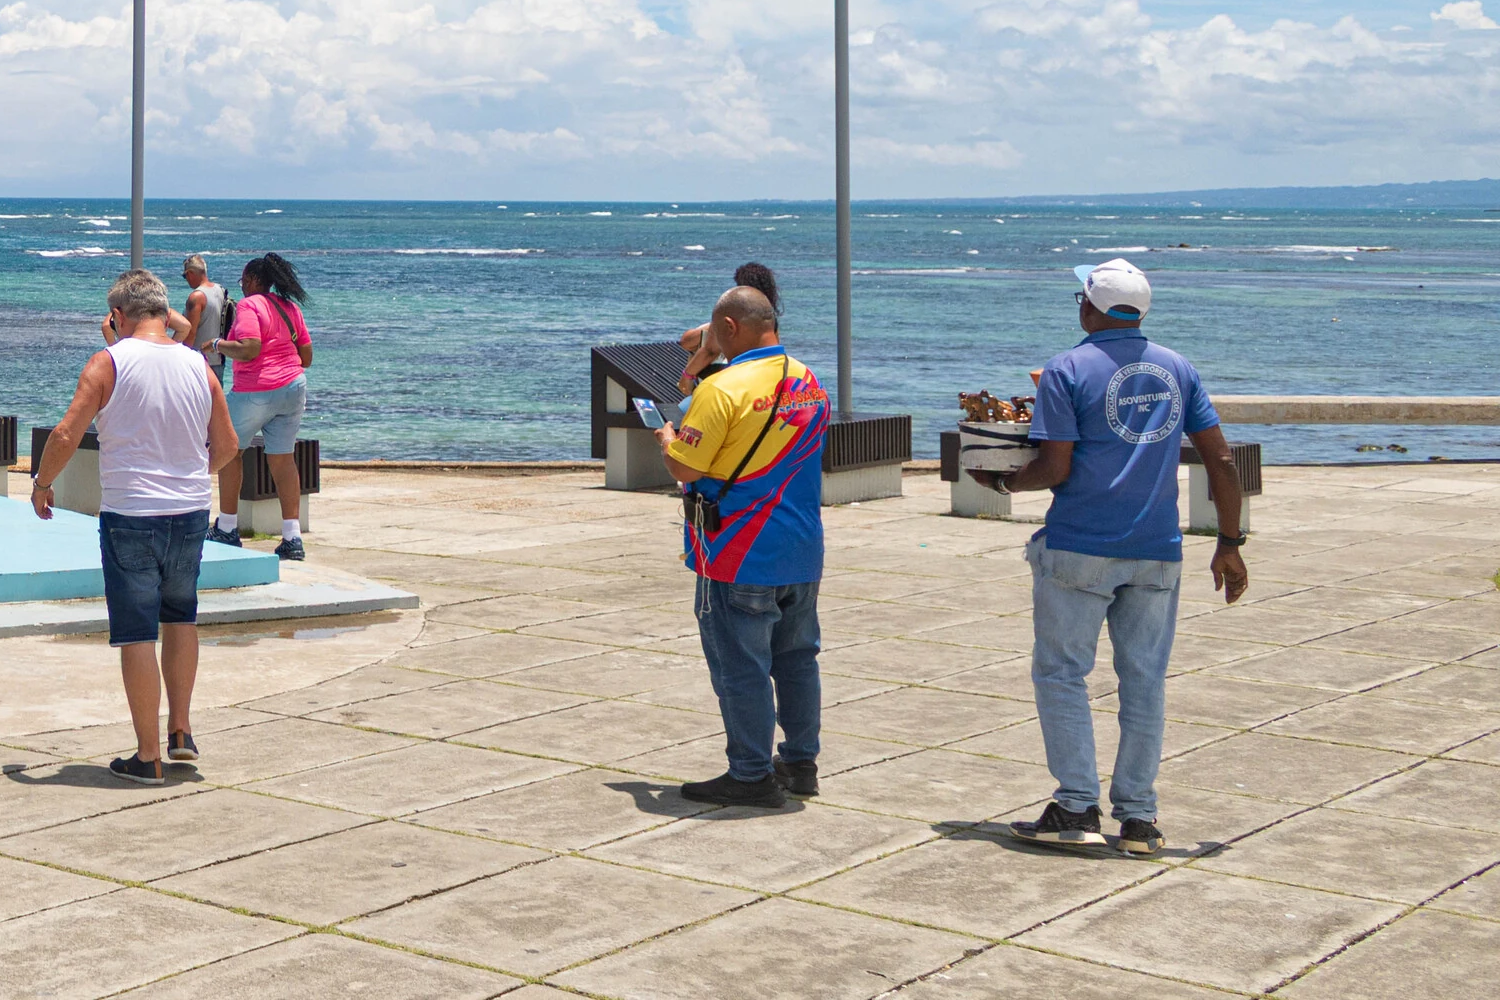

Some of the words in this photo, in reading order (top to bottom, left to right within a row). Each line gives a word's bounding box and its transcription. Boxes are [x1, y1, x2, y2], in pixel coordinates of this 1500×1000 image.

[1108, 381, 1119, 420] ASOCIACION
[1122, 365, 1166, 379] VENDEDORES
[1118, 391, 1172, 407] ASOVENTURIS
[1138, 403, 1151, 413] INC
